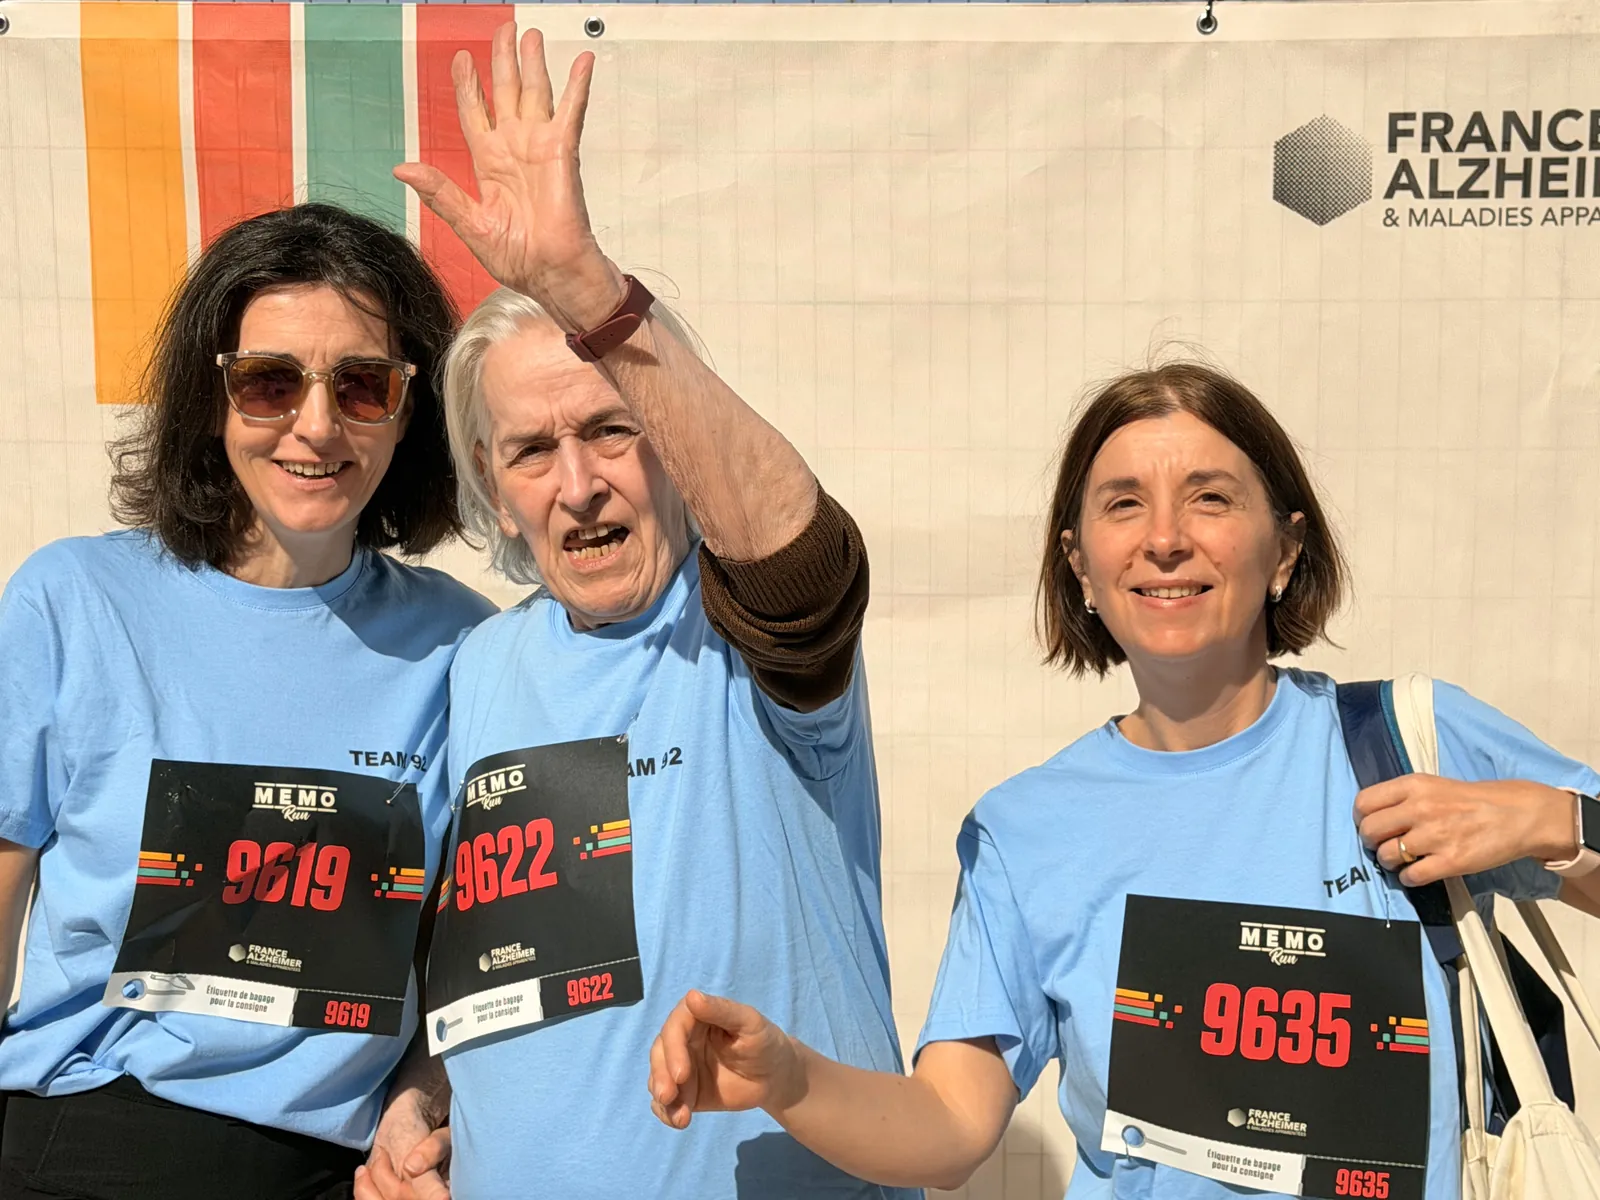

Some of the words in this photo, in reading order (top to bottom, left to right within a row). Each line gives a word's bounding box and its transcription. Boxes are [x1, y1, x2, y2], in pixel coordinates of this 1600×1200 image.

[1383, 156, 1600, 200] ALZHEI
[1382, 207, 1400, 227] &
[1408, 206, 1533, 227] MALADIES
[349, 749, 408, 769] TEAM
[411, 754, 427, 773] 92
[466, 769, 524, 803] MEMO
[254, 786, 336, 808] MEMO
[481, 792, 504, 811] Run
[281, 804, 312, 822] Run
[455, 817, 558, 912] 9622
[222, 839, 351, 912] 9619
[1323, 864, 1372, 898] TEA
[1240, 926, 1324, 951] MEMO
[246, 951, 303, 968] ALZHEIMER
[248, 943, 288, 958] FRANCE
[491, 942, 522, 958] FRANCE
[491, 947, 536, 966] ALZHEIMER
[1268, 946, 1299, 966] Run
[239, 990, 248, 1000] de
[249, 991, 275, 1004] bagage
[567, 972, 615, 1007] 9622
[209, 996, 226, 1006] pour
[227, 998, 235, 1008] la
[235, 1000, 268, 1013] consigne
[324, 1000, 371, 1028] 9619
[1200, 981, 1352, 1068] 9635
[1246, 1116, 1308, 1133] ALZHEIMER
[1248, 1108, 1291, 1122] FRANCE
[1212, 1161, 1229, 1172] pour
[1230, 1164, 1238, 1174] la
[1239, 1167, 1274, 1181] consigne
[1242, 1156, 1252, 1167] de
[1253, 1158, 1282, 1172] bagage
[1335, 1168, 1391, 1199] 9635
